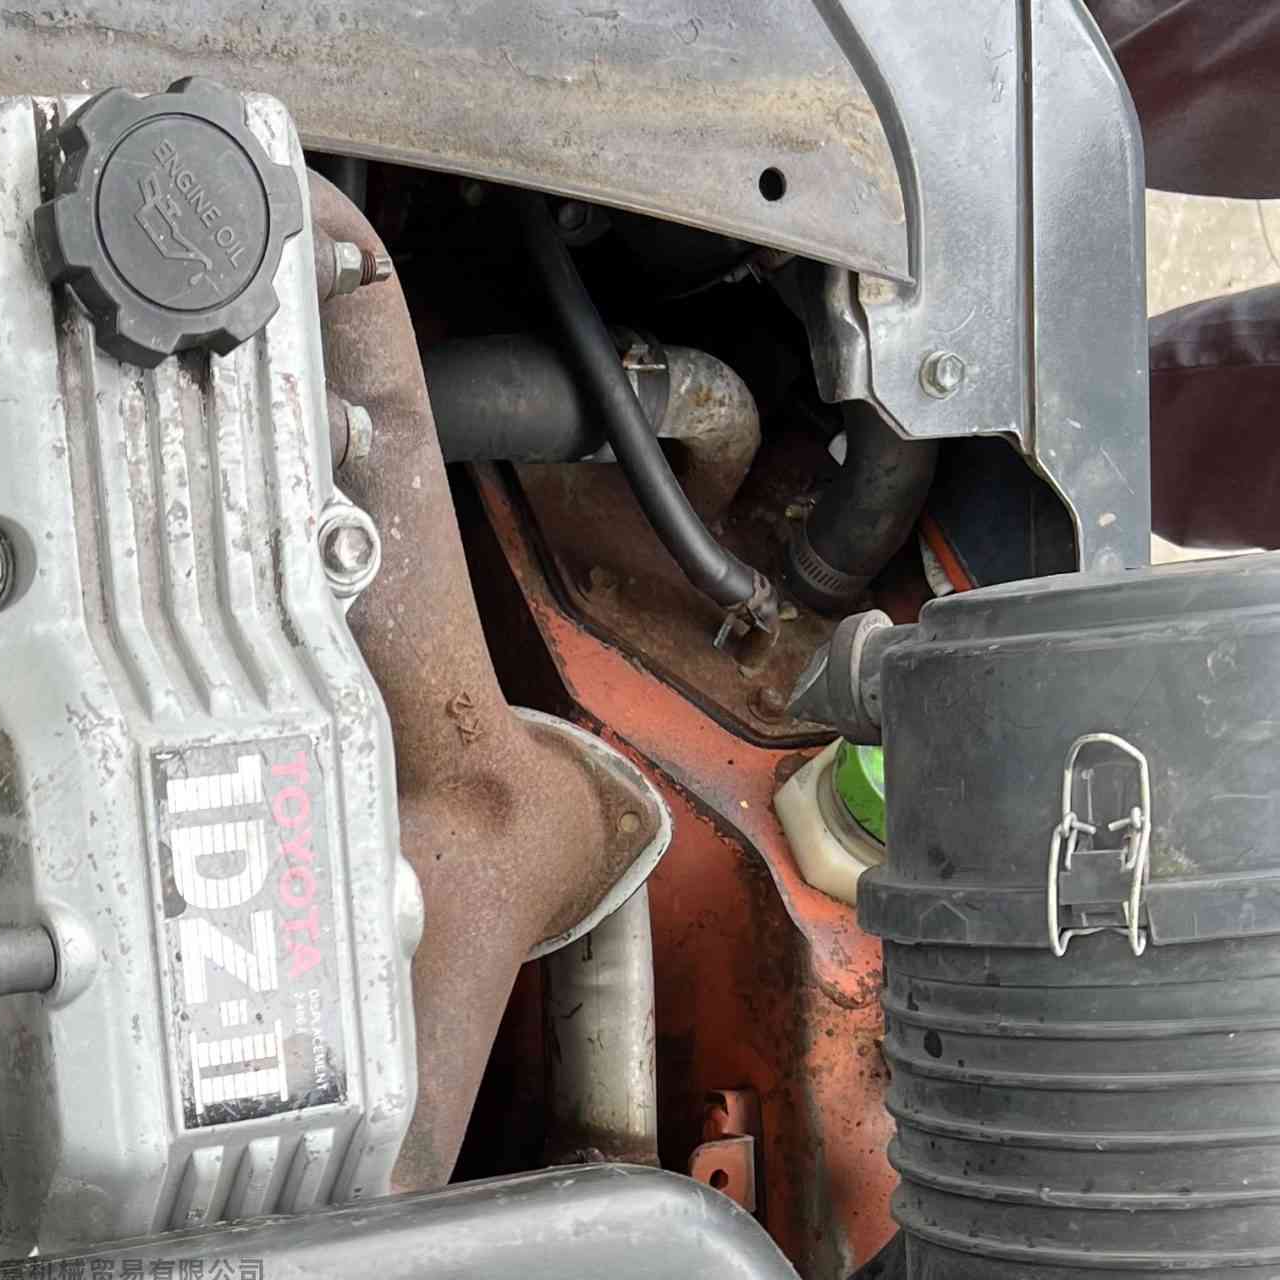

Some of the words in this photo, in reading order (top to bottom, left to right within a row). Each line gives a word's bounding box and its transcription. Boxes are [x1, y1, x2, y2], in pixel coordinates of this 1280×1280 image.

[152, 138, 222, 229] ENGINE
[216, 225, 246, 270] OIL
[271, 751, 321, 977] TOYOTA
